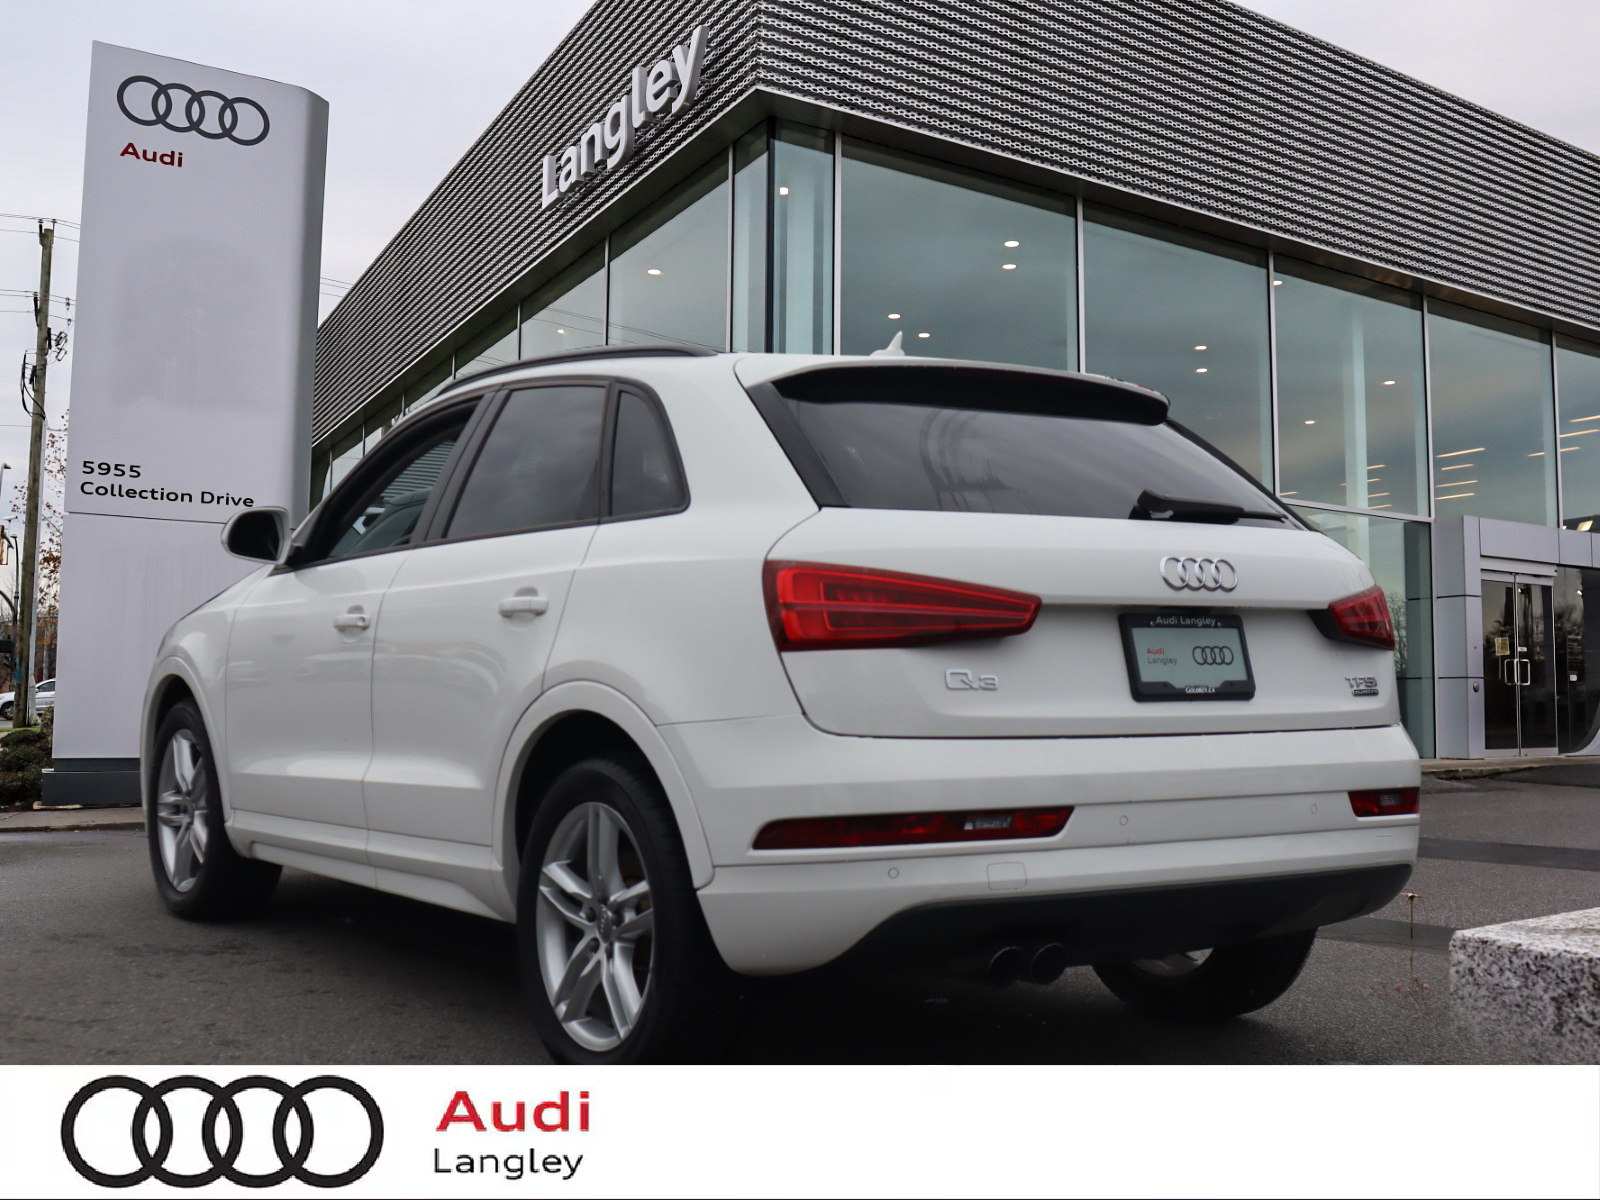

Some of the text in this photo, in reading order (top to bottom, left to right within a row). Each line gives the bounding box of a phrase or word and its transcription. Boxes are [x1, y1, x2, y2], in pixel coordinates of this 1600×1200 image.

[542, 25, 709, 209] Langley
[120, 142, 183, 167] Audi
[81, 460, 141, 478] 5955
[79, 481, 255, 507] Collection Drive
[1156, 616, 1216, 627] Audi Langley
[1146, 647, 1165, 655] Audi
[945, 669, 999, 691] Q3
